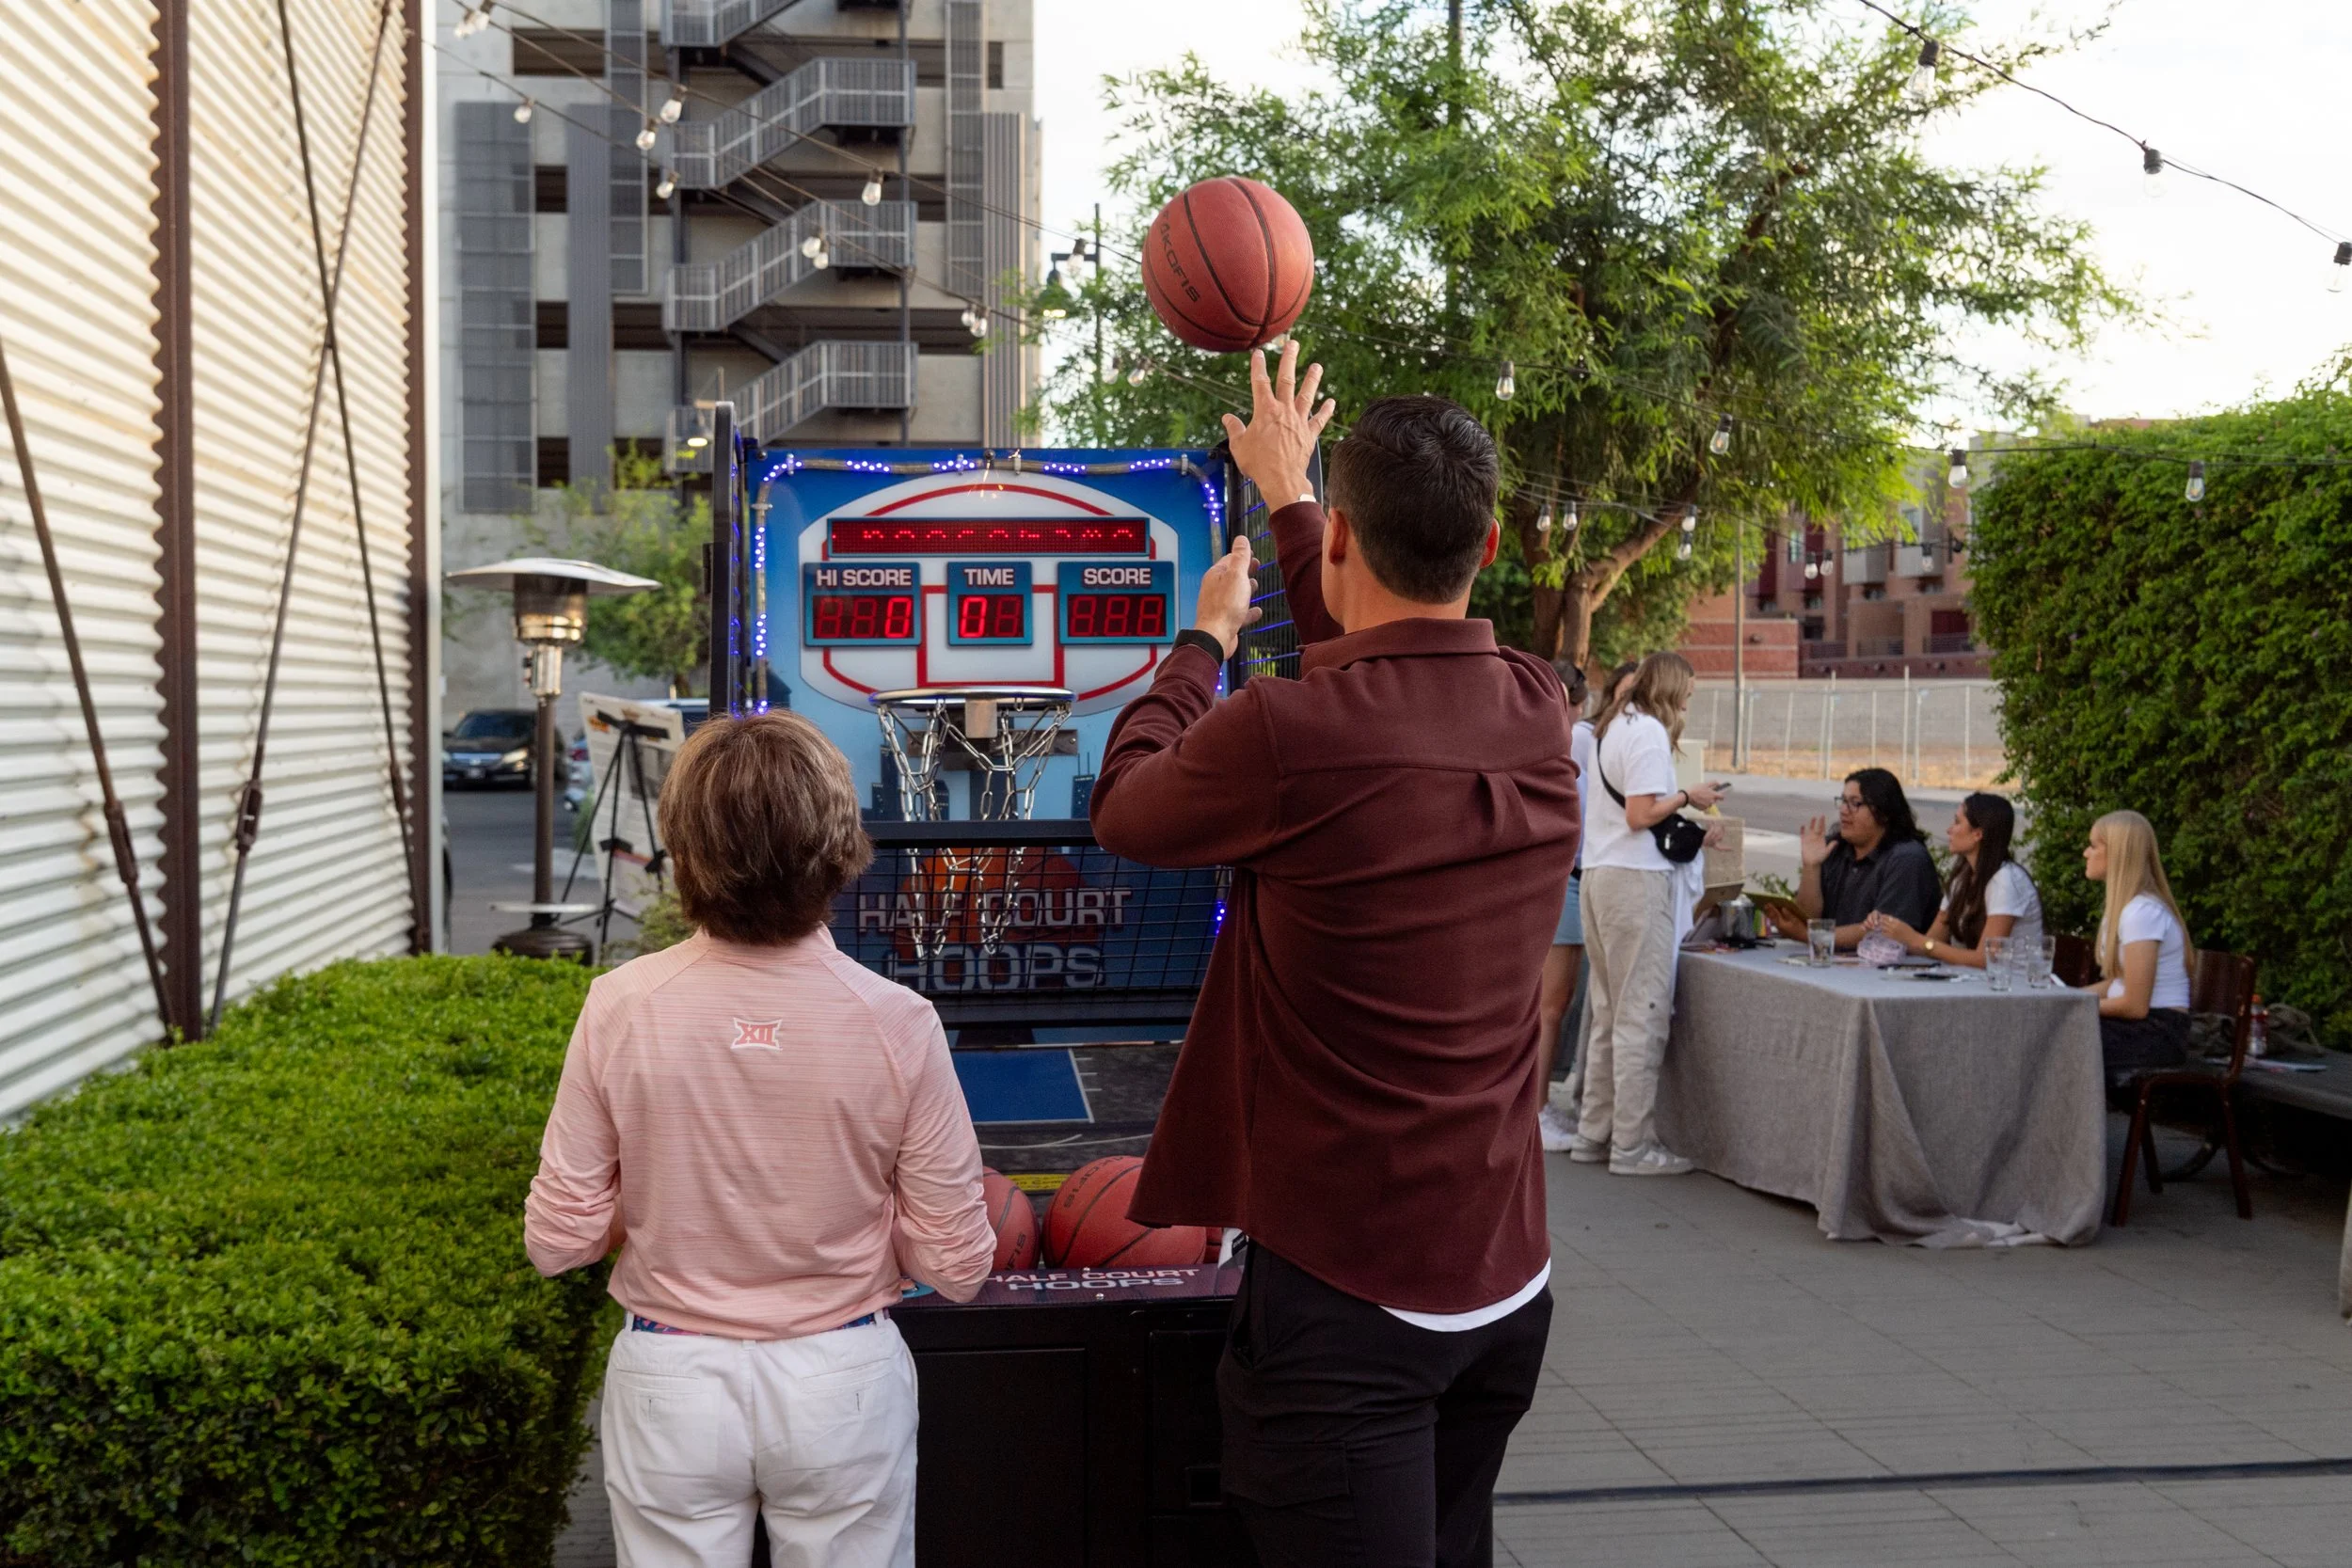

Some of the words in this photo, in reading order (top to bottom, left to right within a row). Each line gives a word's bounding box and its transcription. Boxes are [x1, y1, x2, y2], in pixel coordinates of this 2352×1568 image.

[816, 568, 837, 587] HI
[842, 568, 912, 587] SCORE
[963, 567, 1015, 586] TIME
[1083, 567, 1152, 586] SCORE
[858, 892, 963, 933] HALF
[983, 888, 1133, 927] COURT
[886, 944, 1104, 990] HOOPS
[1082, 1268, 1200, 1280] COURT
[1009, 1277, 1184, 1291] HOOPS
